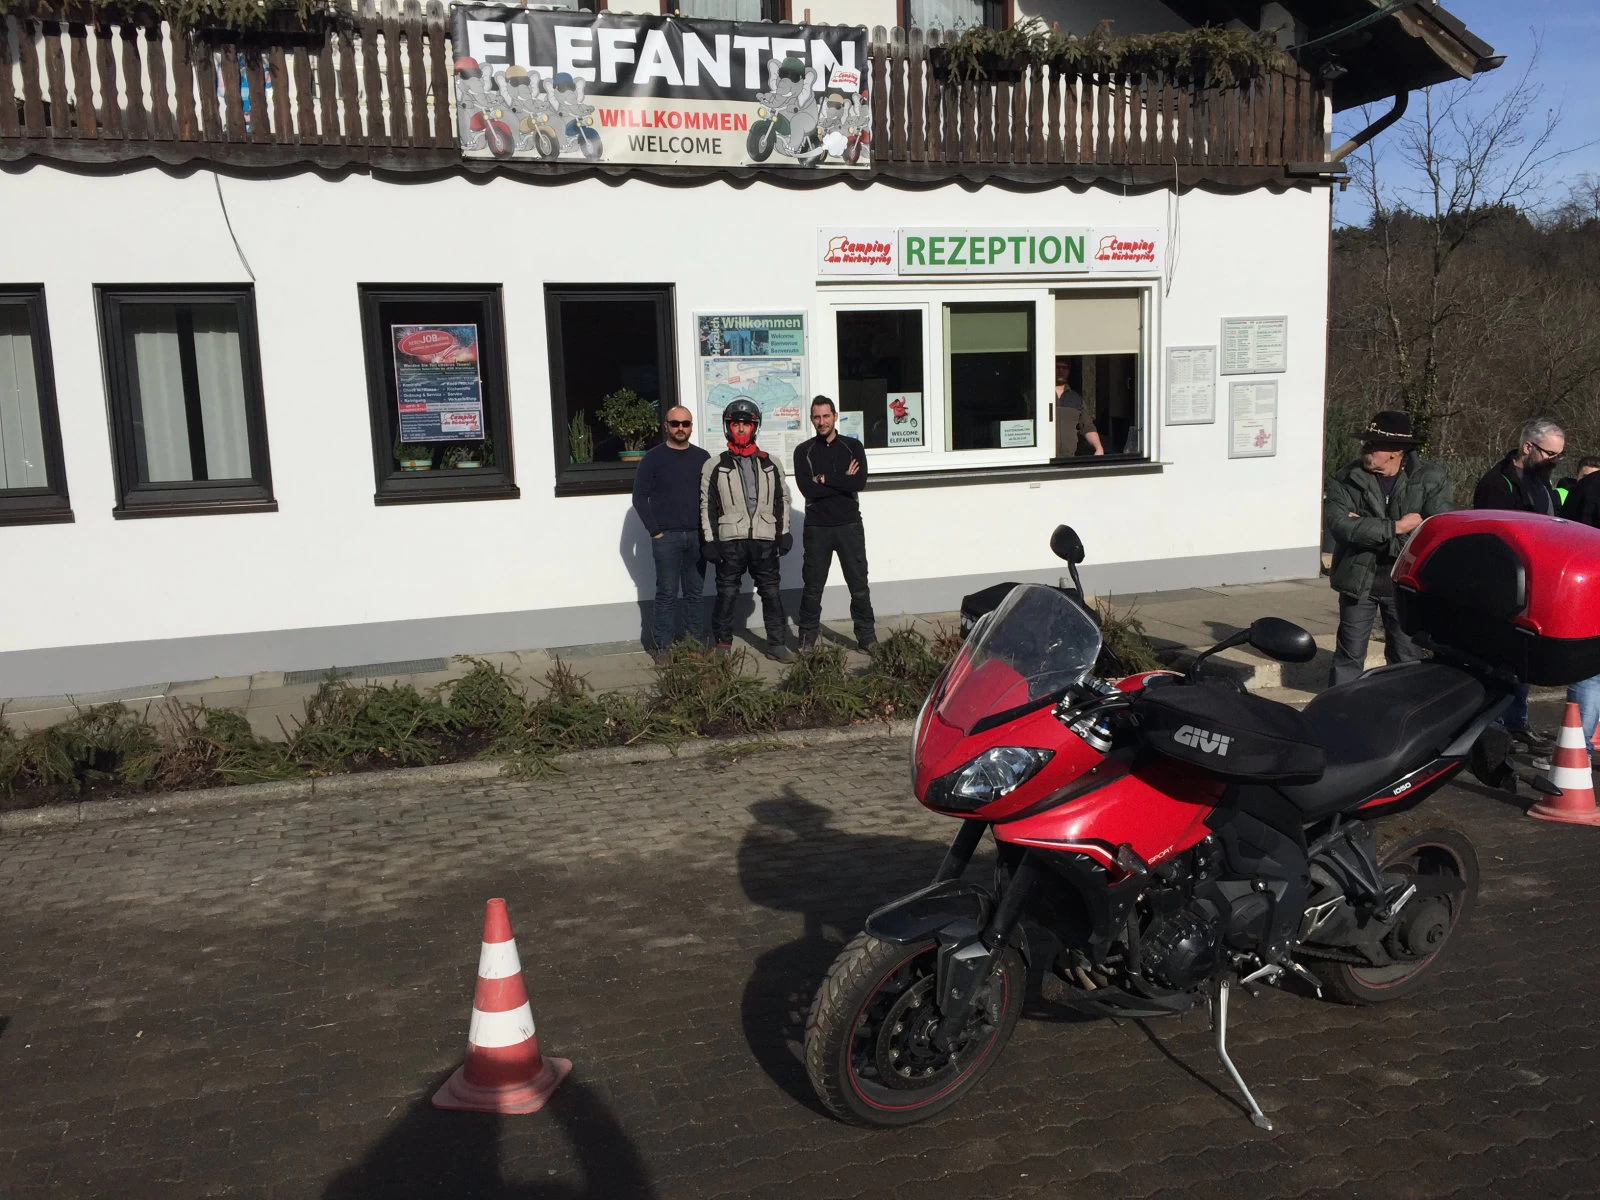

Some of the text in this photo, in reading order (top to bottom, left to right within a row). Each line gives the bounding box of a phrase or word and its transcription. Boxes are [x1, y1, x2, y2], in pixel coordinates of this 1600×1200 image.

[599, 108, 748, 131] WILLKOMMEN
[628, 135, 722, 155] WELCOME
[841, 239, 891, 255] Camping
[907, 235, 1085, 266] REZEPTION
[1109, 238, 1154, 253] Camping
[829, 252, 892, 266] am Nürburgring
[1098, 250, 1154, 263] am Nürburgring
[721, 316, 801, 329] Willkommen
[1174, 724, 1231, 757] GIVI
[1147, 845, 1174, 865] SPORT
